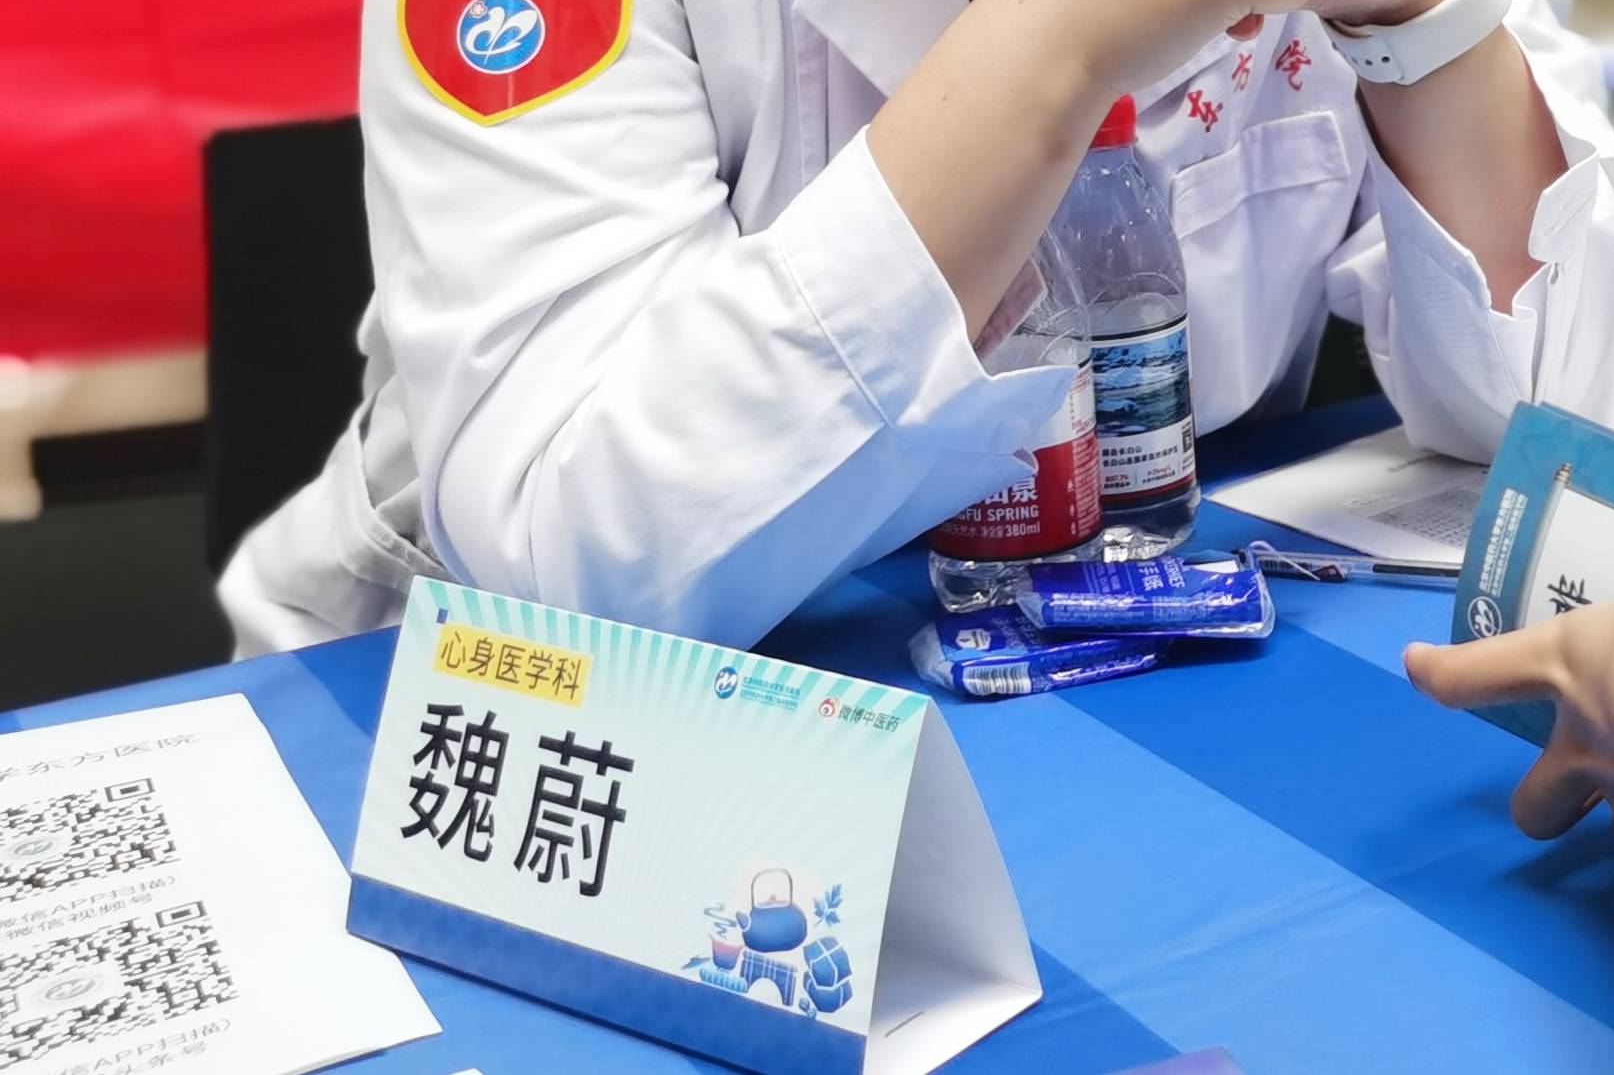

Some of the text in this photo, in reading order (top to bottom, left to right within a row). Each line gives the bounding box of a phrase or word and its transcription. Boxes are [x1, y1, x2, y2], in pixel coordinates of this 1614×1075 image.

[987, 505, 1040, 522] SPRING
[440, 630, 582, 700] 心身医学科
[400, 703, 635, 897] 魏蔚
